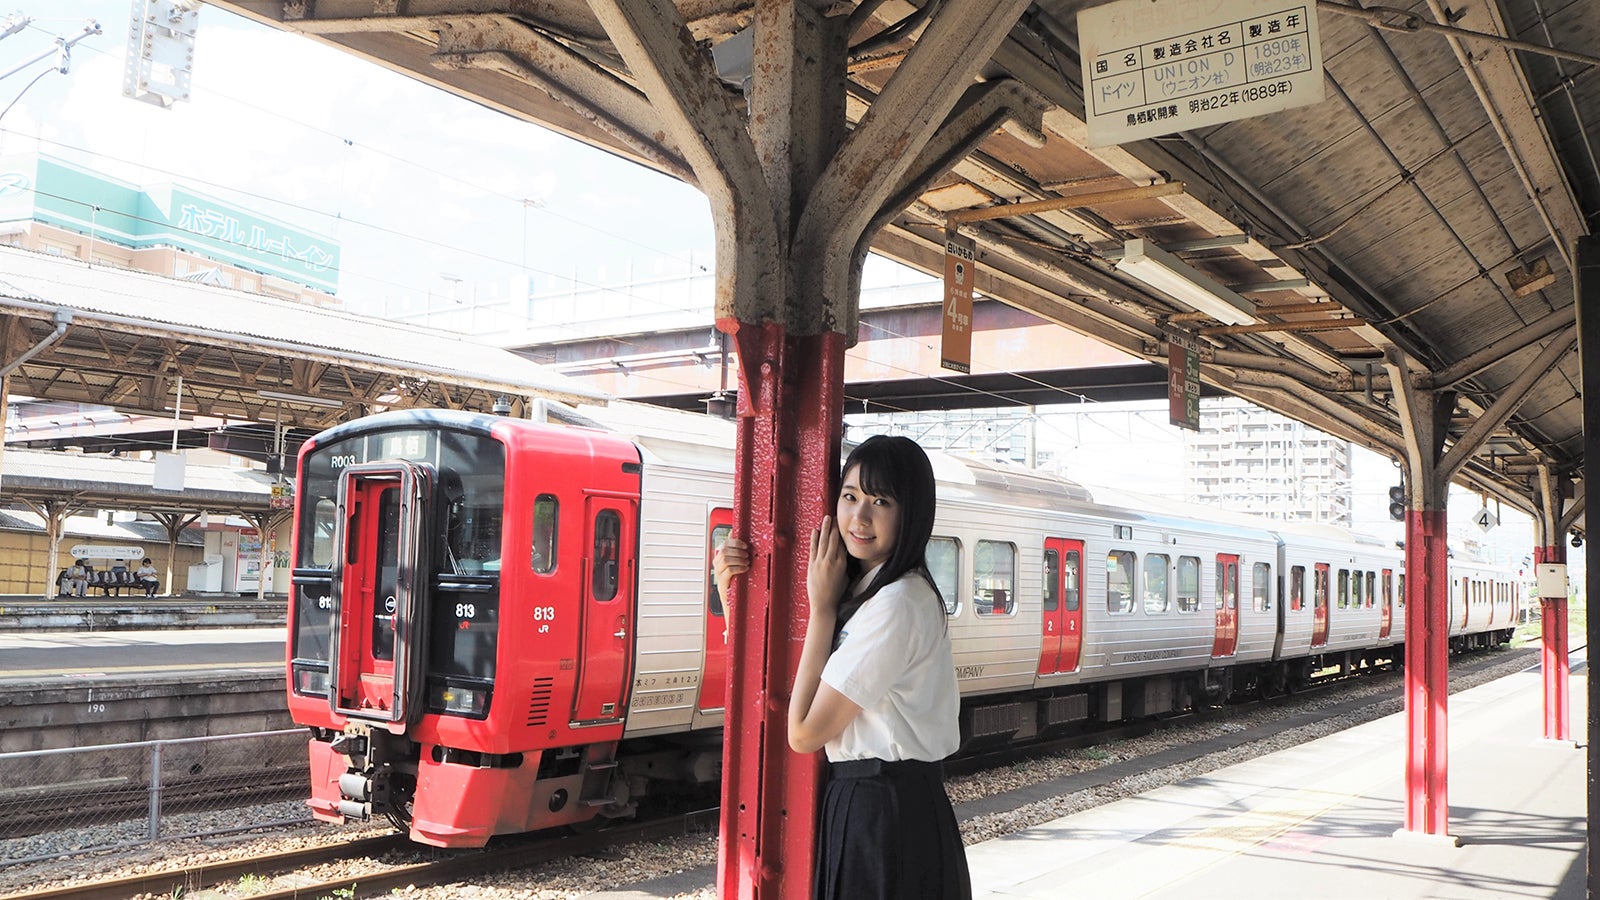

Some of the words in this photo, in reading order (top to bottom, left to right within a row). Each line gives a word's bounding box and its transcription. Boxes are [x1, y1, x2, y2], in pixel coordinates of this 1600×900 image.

[1249, 14, 1301, 37] 製造年
[1152, 31, 1232, 59] 製造会社名
[1254, 38, 1301, 59] 1890年
[1154, 58, 1210, 82] UNION
[1223, 52, 1235, 67] D
[1101, 81, 1136, 103] ドイツ
[1126, 104, 1178, 127] 鳥栖駅開業
[179, 203, 245, 244] ホテル
[247, 224, 335, 273] ルートイン
[331, 455, 356, 468] R003
[1478, 512, 1489, 527] 4
[455, 603, 475, 618] 813
[533, 606, 555, 621] 813
[458, 620, 471, 630] JR
[538, 624, 549, 633] JR
[1047, 620, 1053, 631] 2
[1069, 619, 1075, 631] 2
[88, 704, 105, 713] 190
